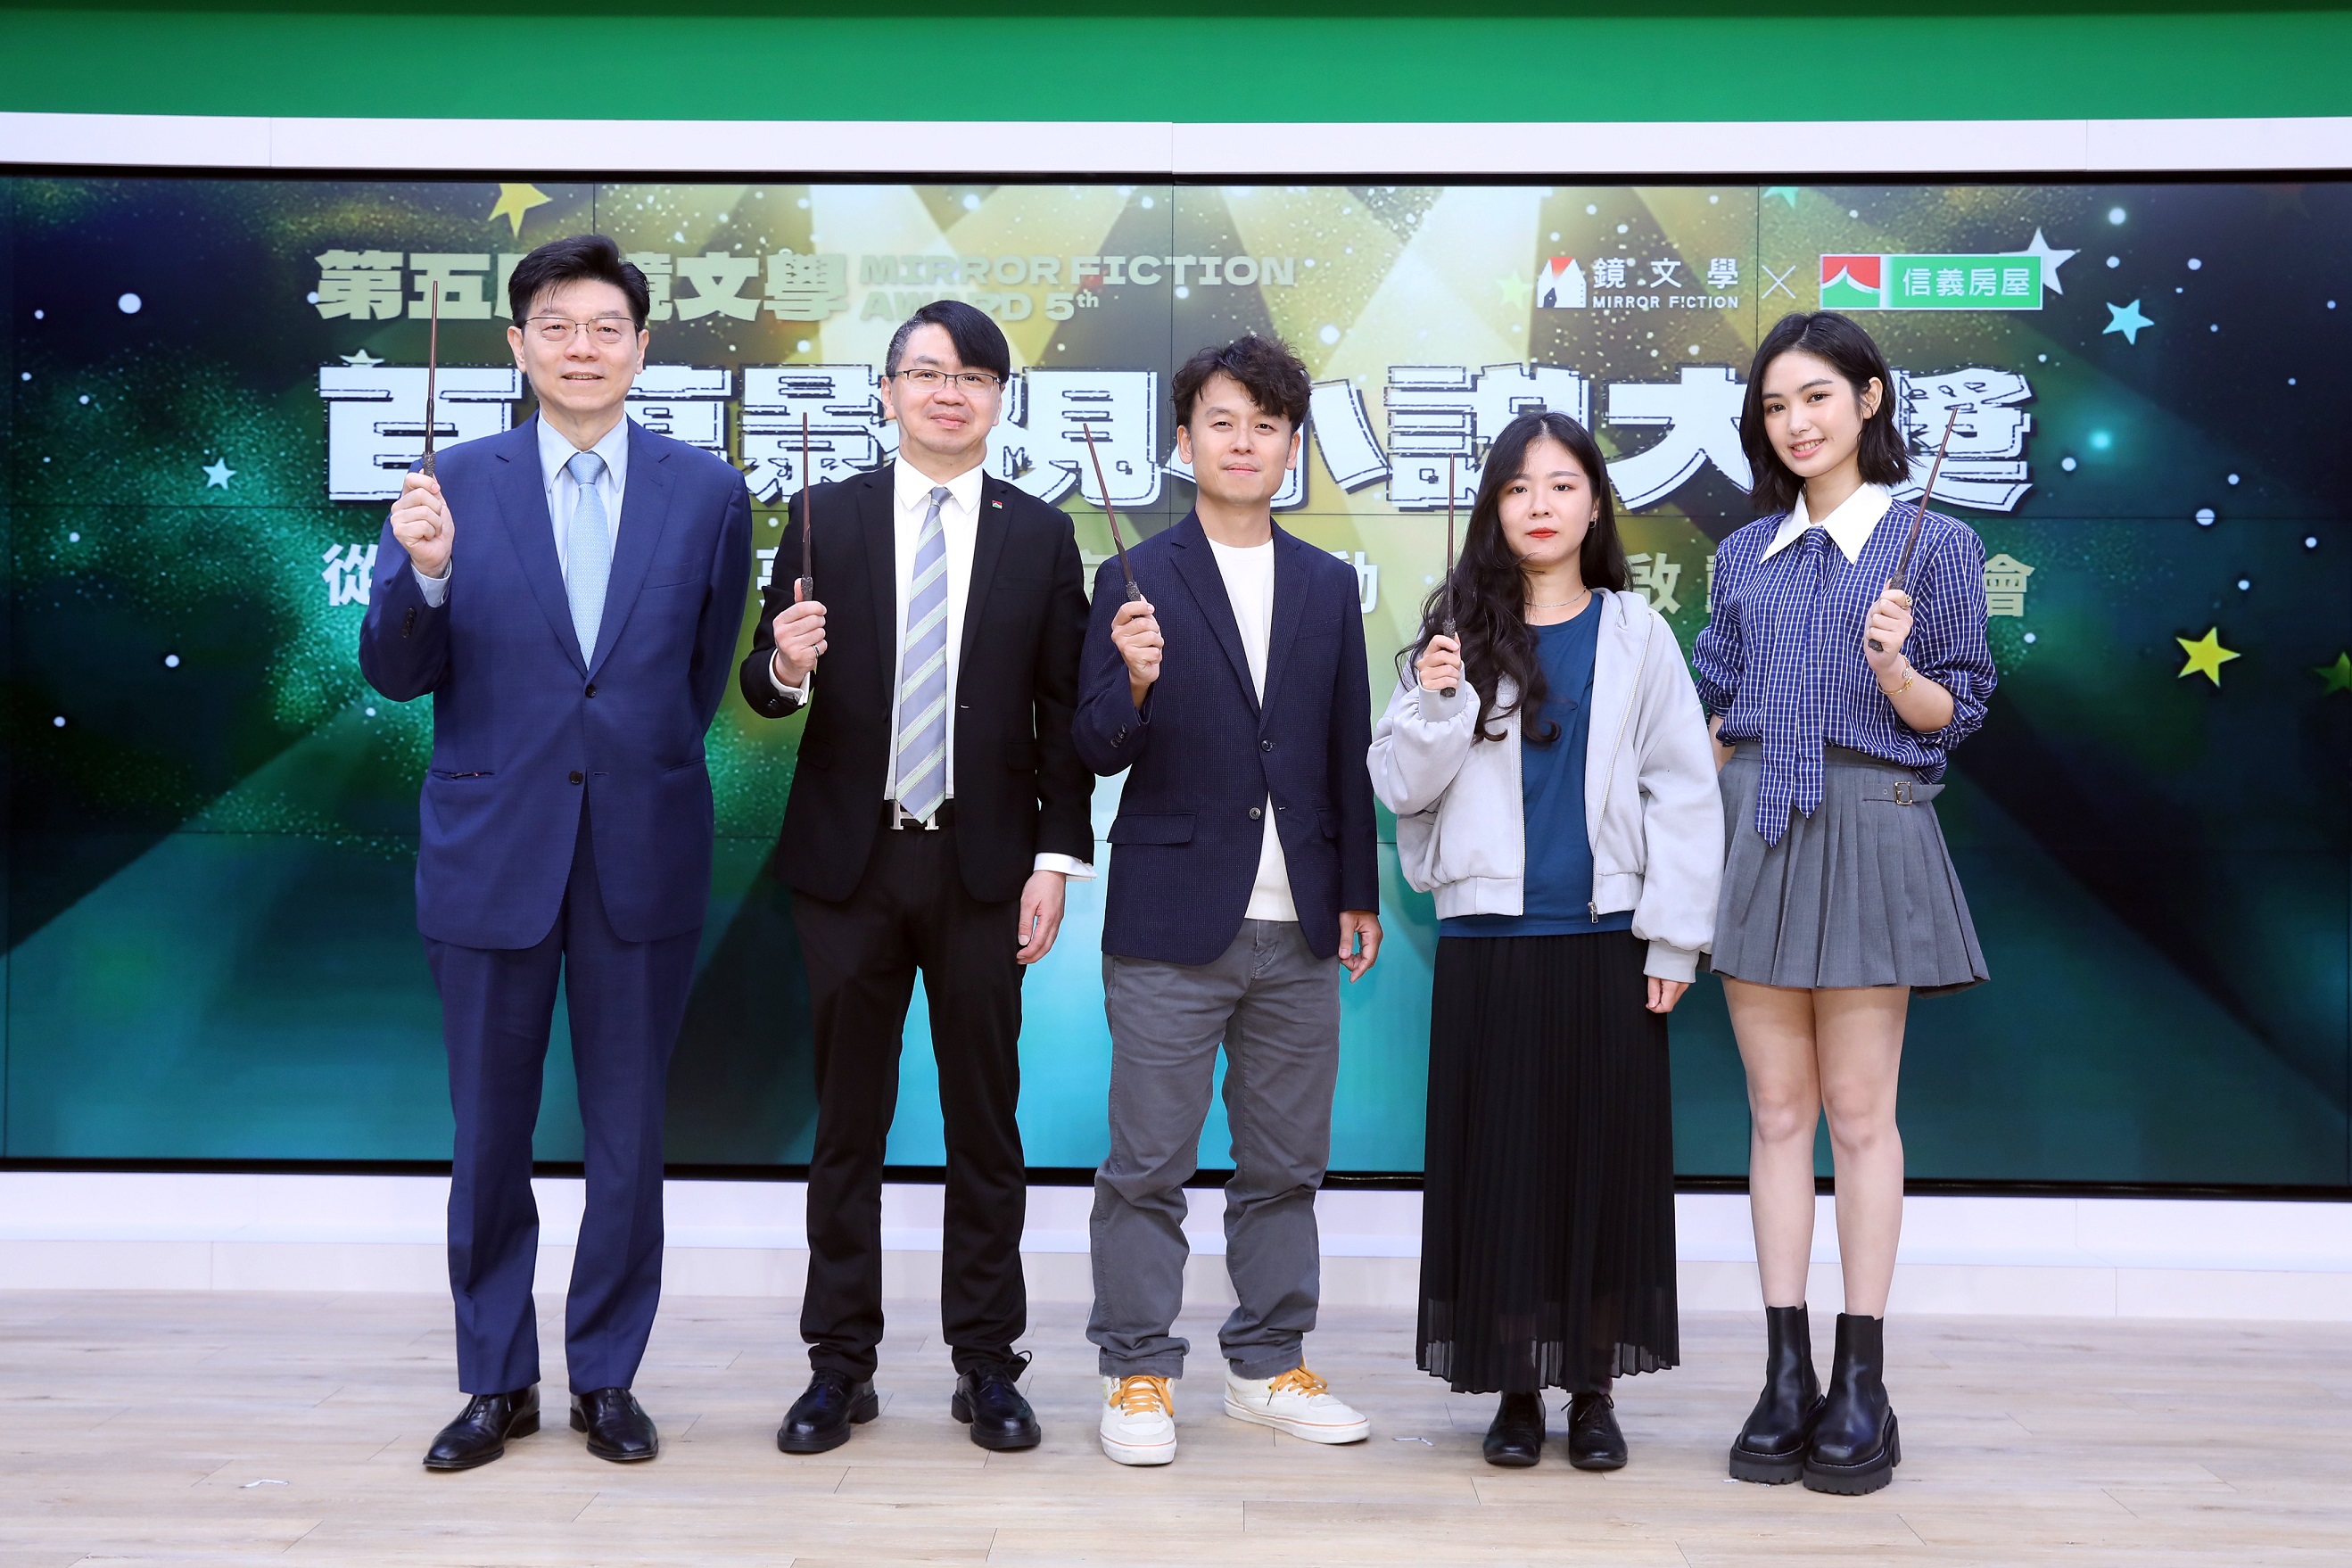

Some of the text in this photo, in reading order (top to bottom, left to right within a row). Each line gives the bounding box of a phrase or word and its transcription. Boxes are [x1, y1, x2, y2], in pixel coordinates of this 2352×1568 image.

[315, 249, 848, 322] 第五文學
[859, 254, 1295, 286] MIRROR FICTION
[1592, 257, 1739, 290] 鏡文學
[1902, 267, 2031, 297] 信義房屋
[859, 290, 1100, 322] AWRD 5th
[1592, 295, 1661, 309] MIRROR
